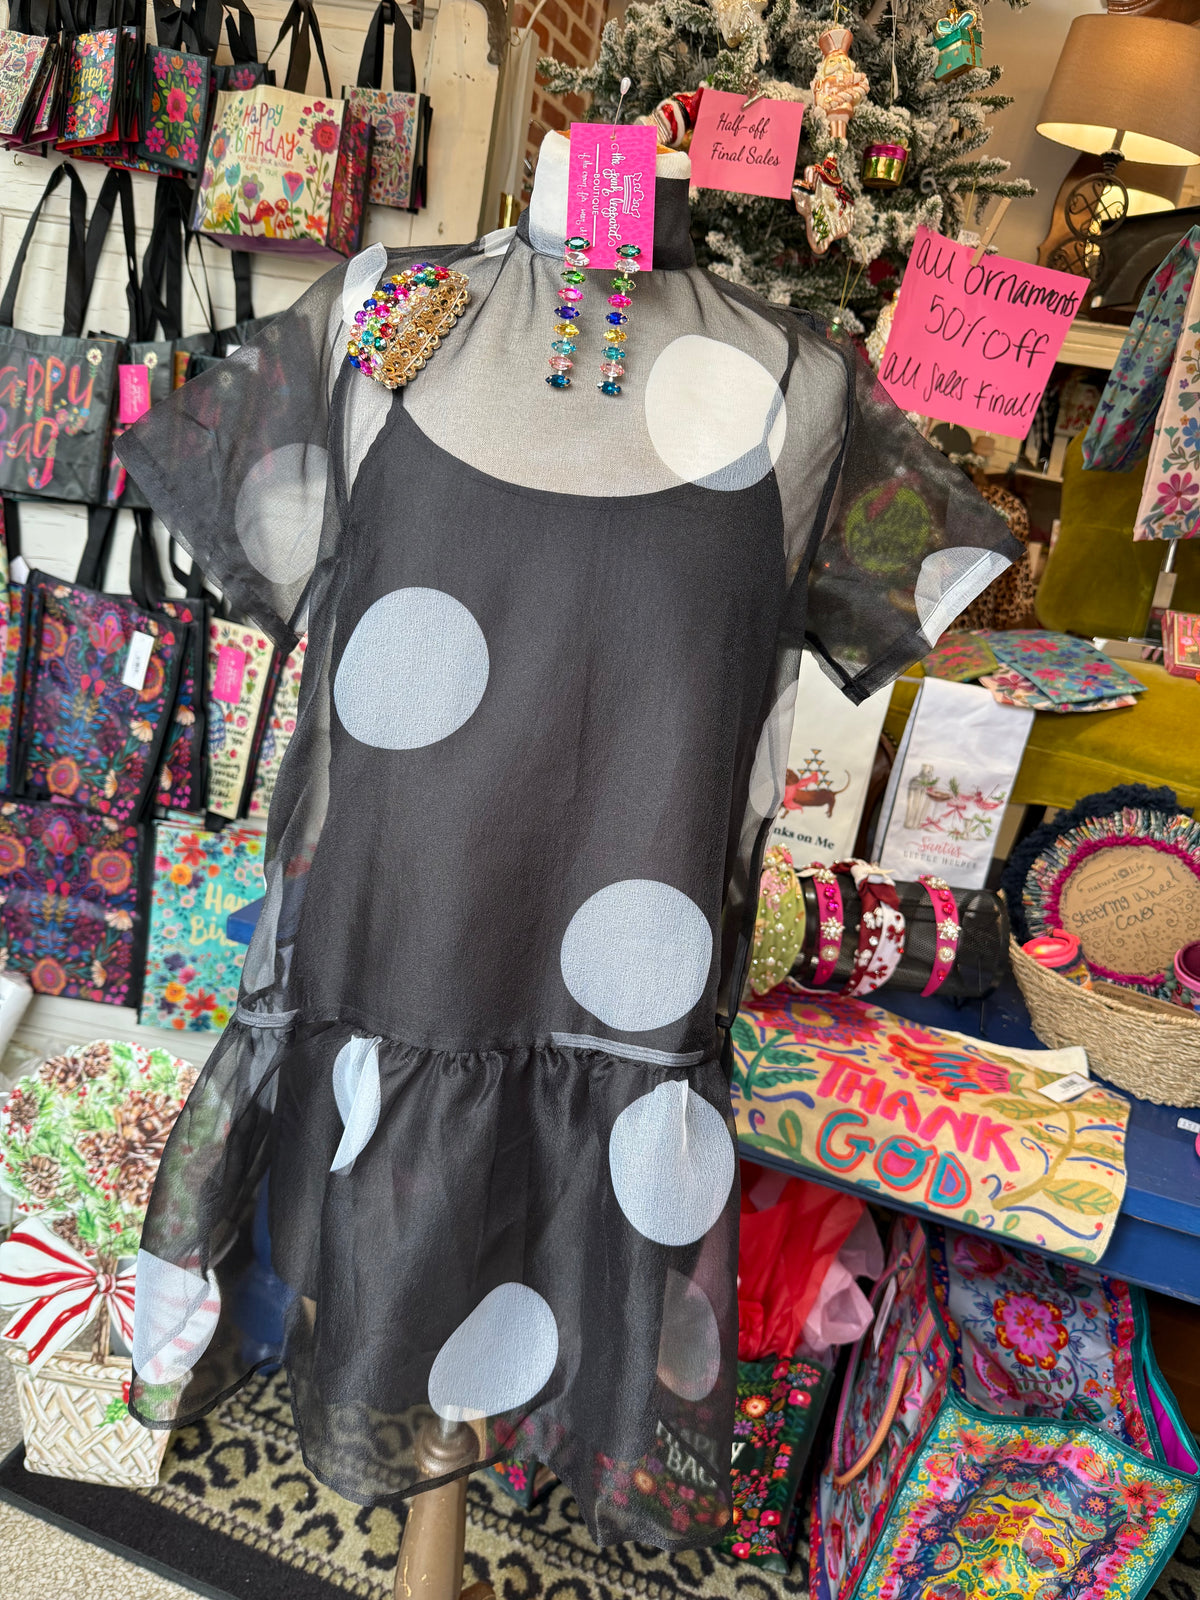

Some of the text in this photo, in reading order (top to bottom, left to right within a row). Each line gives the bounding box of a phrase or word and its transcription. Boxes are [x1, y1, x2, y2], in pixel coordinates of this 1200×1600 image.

[716, 112, 770, 140] Half-off
[611, 143, 626, 165] the
[711, 142, 779, 166] Final Sales
[592, 173, 600, 215] BOUTIQUE
[602, 198, 624, 247] leopard
[925, 294, 986, 347] 50%
[0, 355, 96, 437] appy
[773, 826, 836, 850] nks on Me
[205, 882, 250, 914] Hap
[1072, 895, 1130, 929] Steering
[1115, 902, 1159, 931] Cover
[815, 1050, 1020, 1173] THANK
[815, 1108, 972, 1209] GOD
